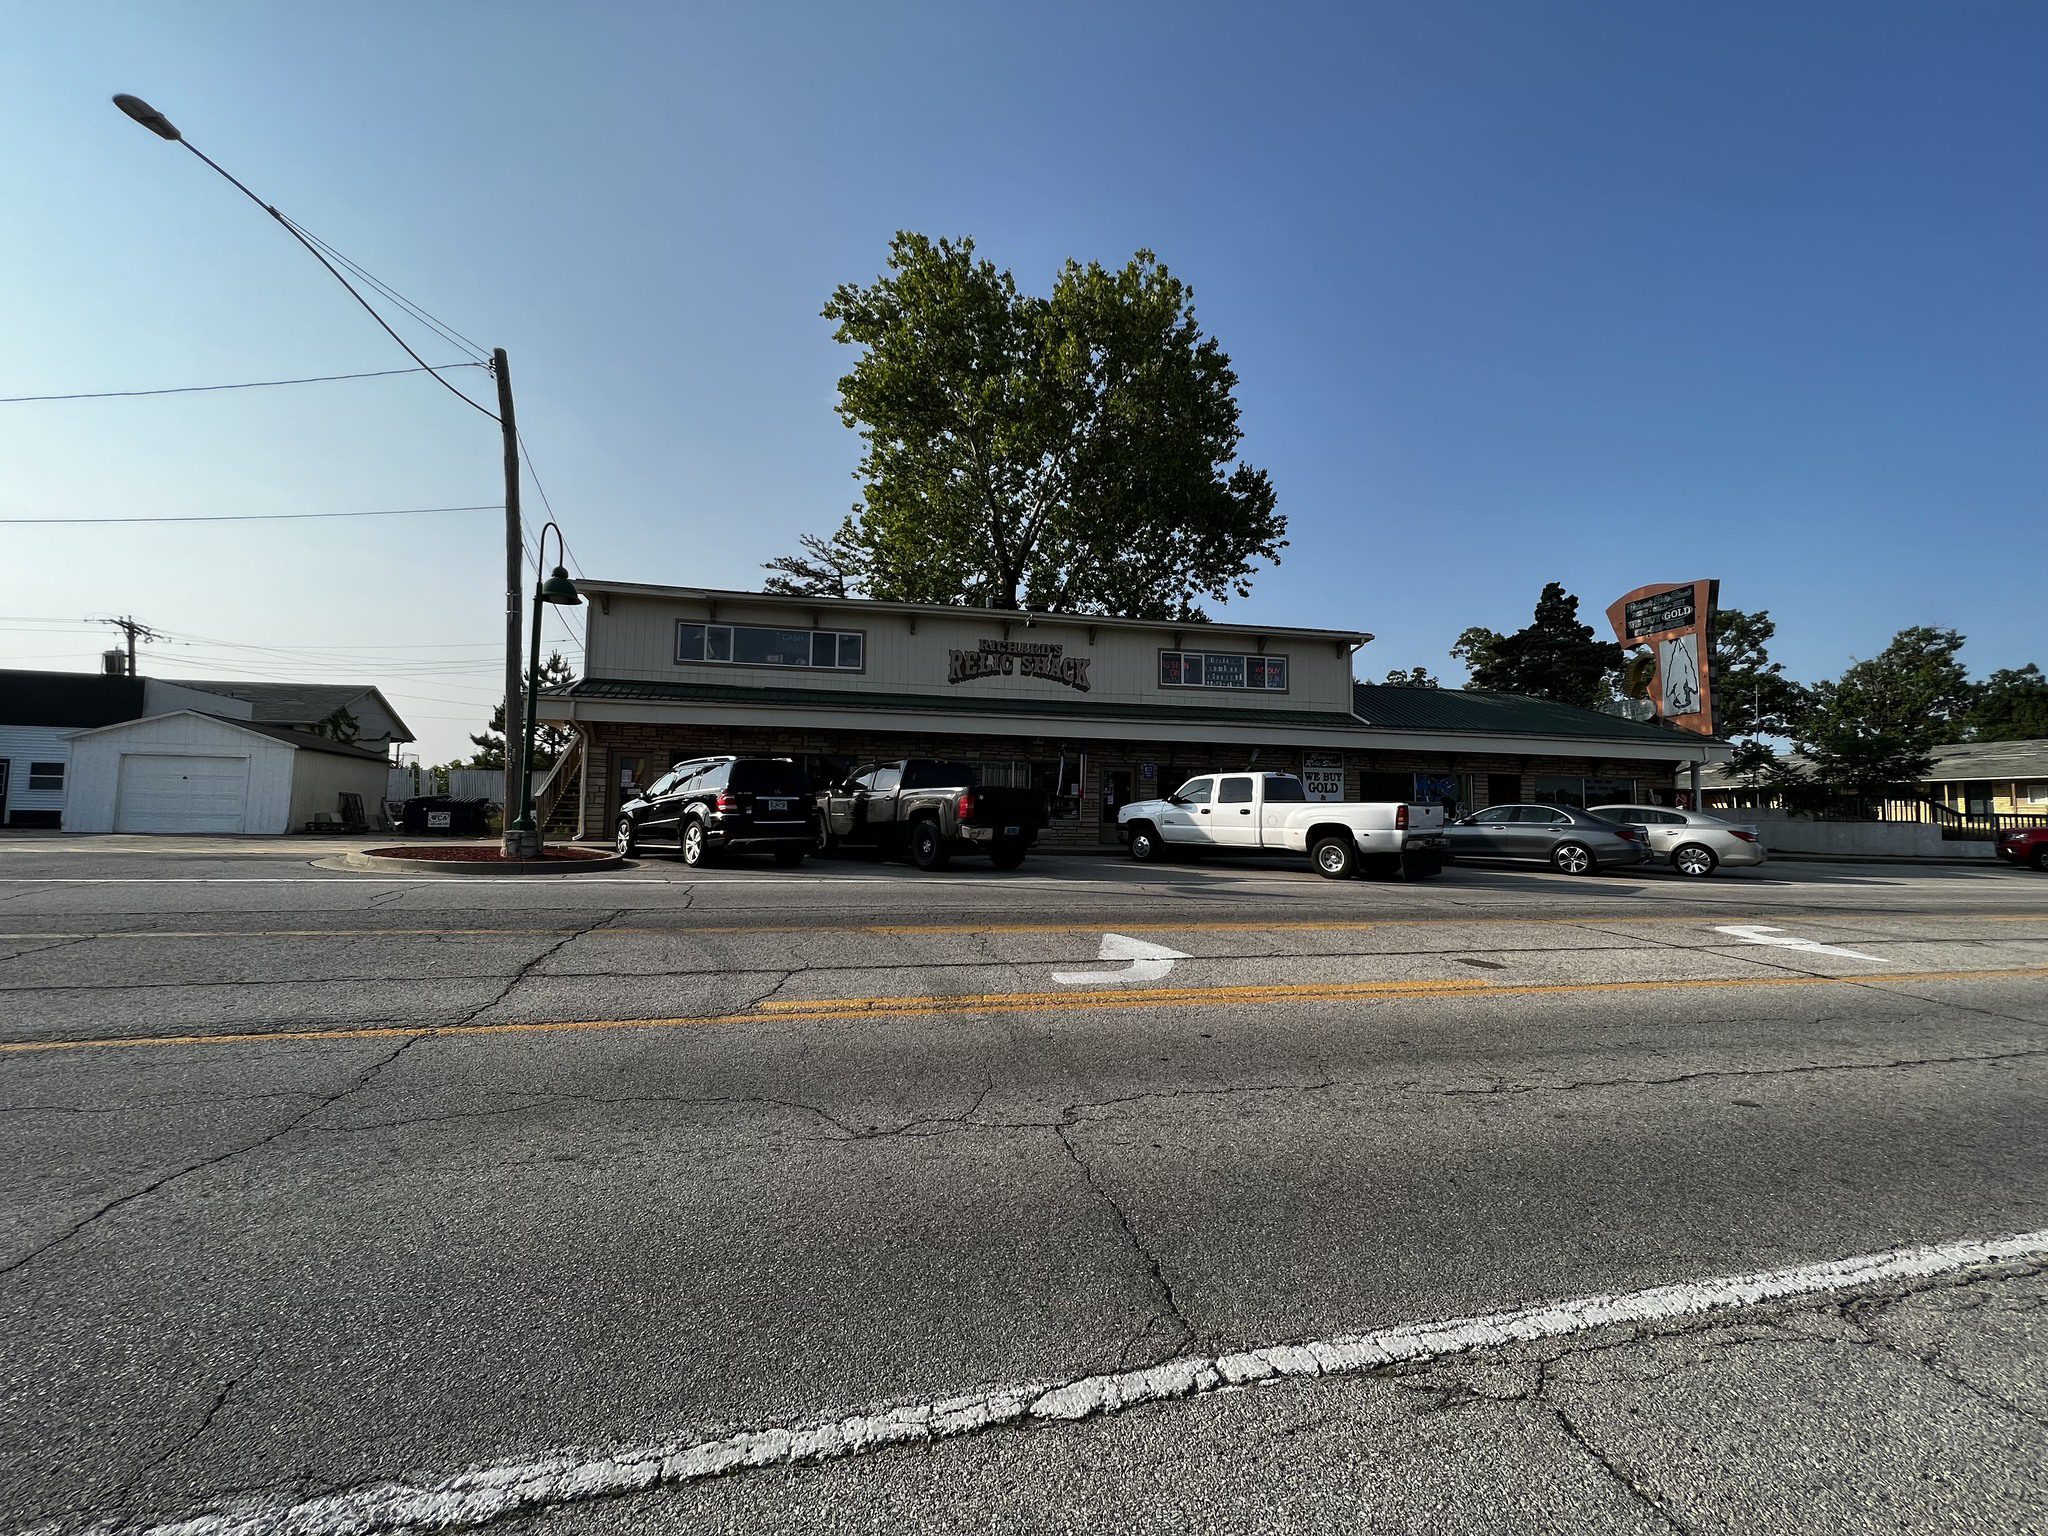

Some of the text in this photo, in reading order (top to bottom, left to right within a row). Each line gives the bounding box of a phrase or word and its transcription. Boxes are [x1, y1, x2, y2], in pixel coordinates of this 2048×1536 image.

[1664, 606, 1691, 620] GOLD
[979, 639, 1063, 657] RICHARD'S
[947, 649, 1091, 692] RELIC SHACK
[1172, 662, 1190, 670] SEN
[1304, 772, 1342, 782] WE BUY
[1308, 782, 1339, 793] GOLD
